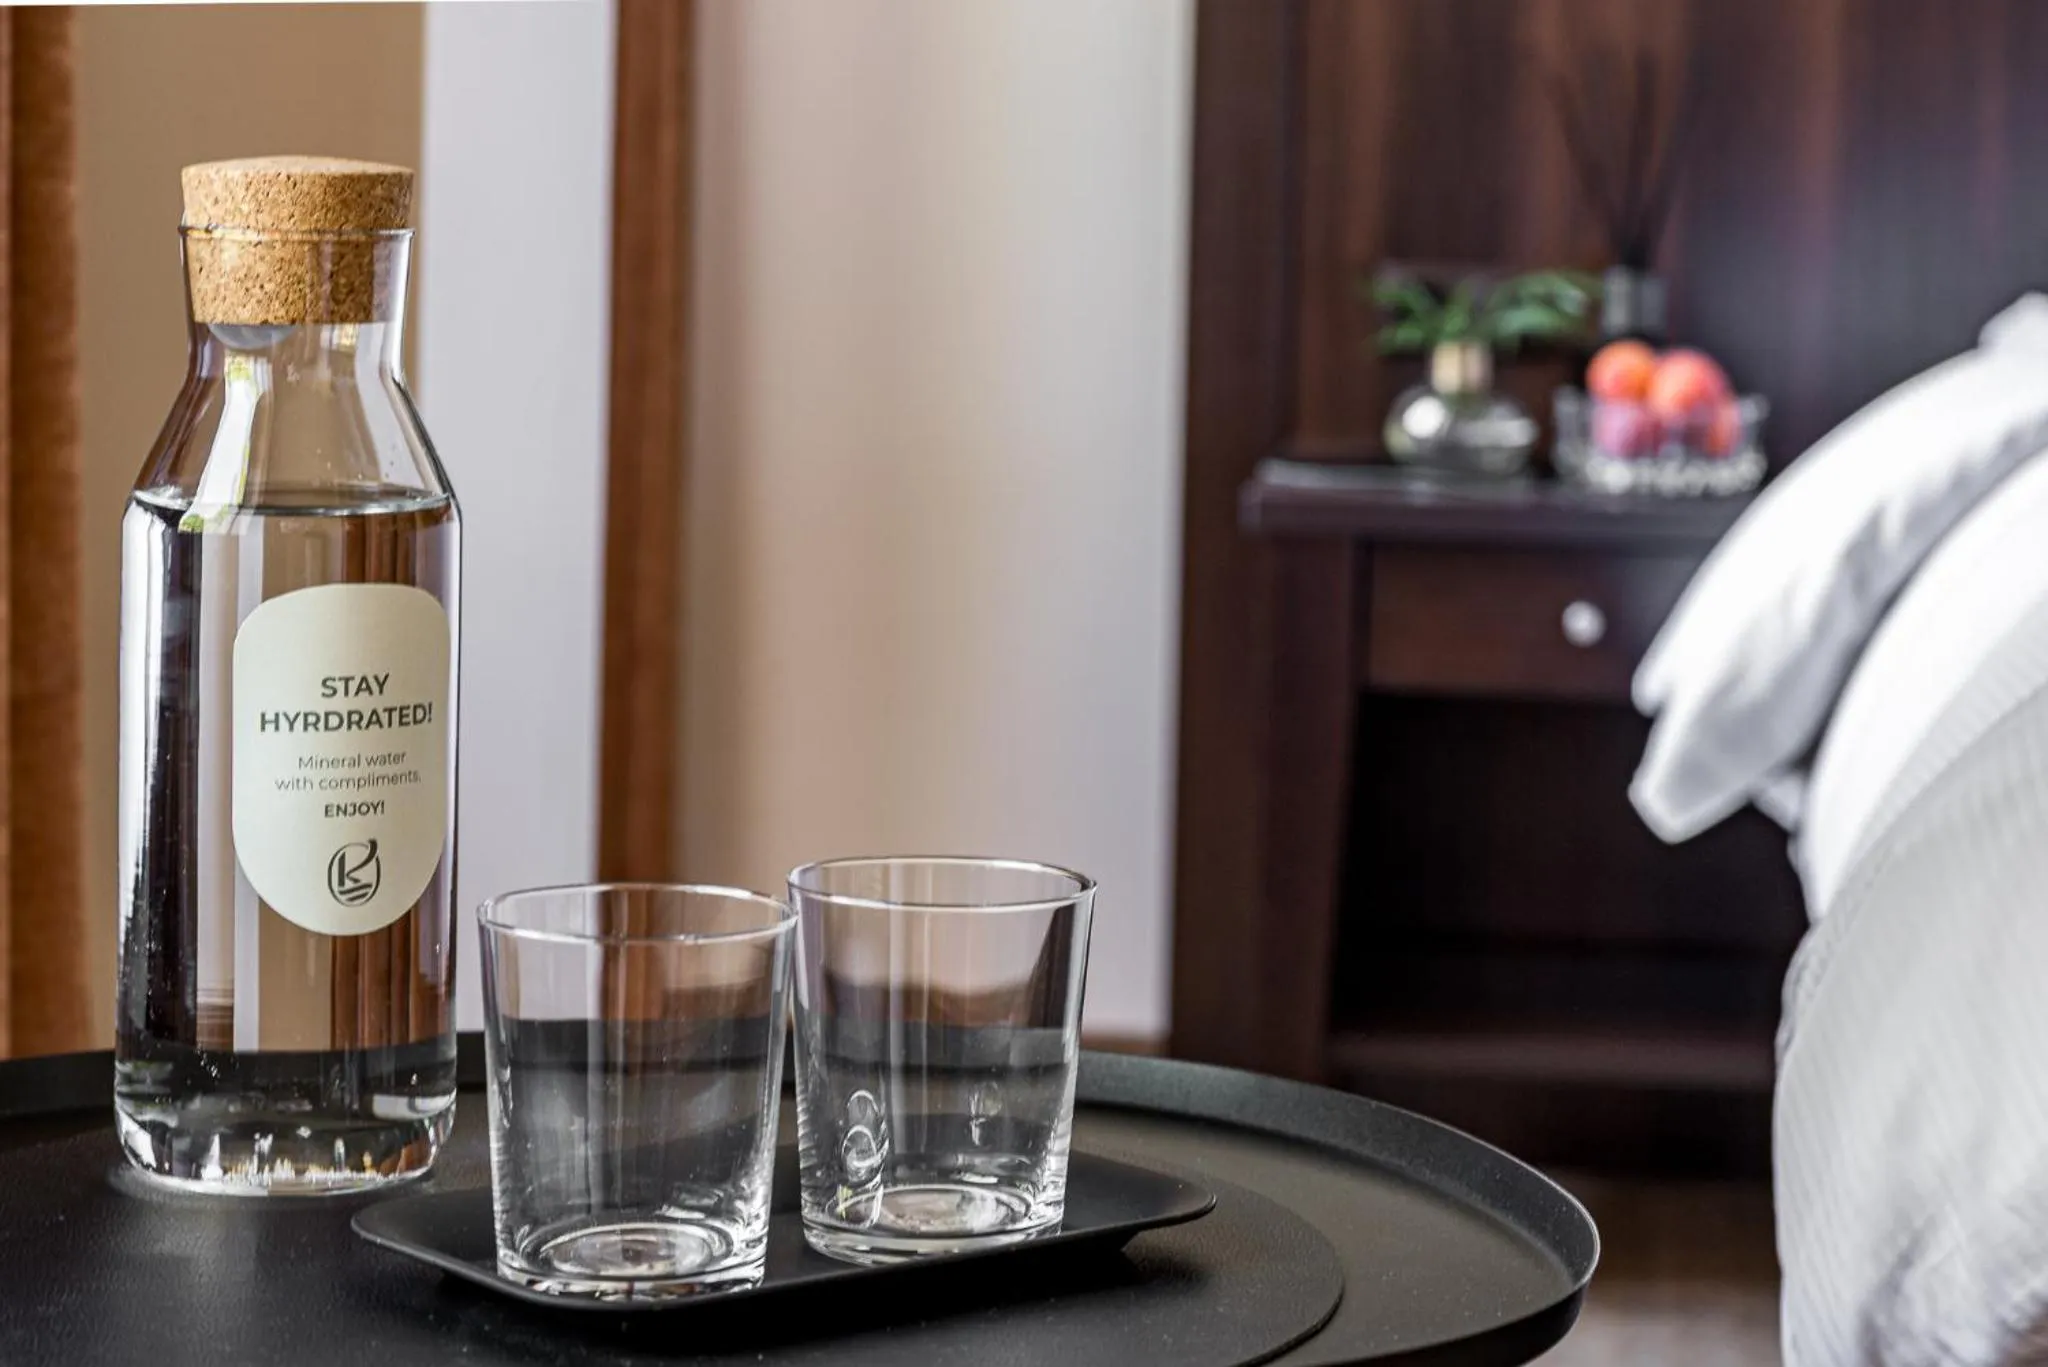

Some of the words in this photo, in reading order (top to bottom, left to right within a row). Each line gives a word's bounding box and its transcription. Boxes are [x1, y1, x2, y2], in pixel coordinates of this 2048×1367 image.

[320, 673, 390, 698] STAY
[260, 702, 433, 732] HYRDRATED!
[298, 753, 361, 770] Mineral
[364, 751, 407, 768] water
[275, 778, 314, 791] with
[318, 770, 422, 792] compliments.
[323, 800, 385, 818] ENJOY!
